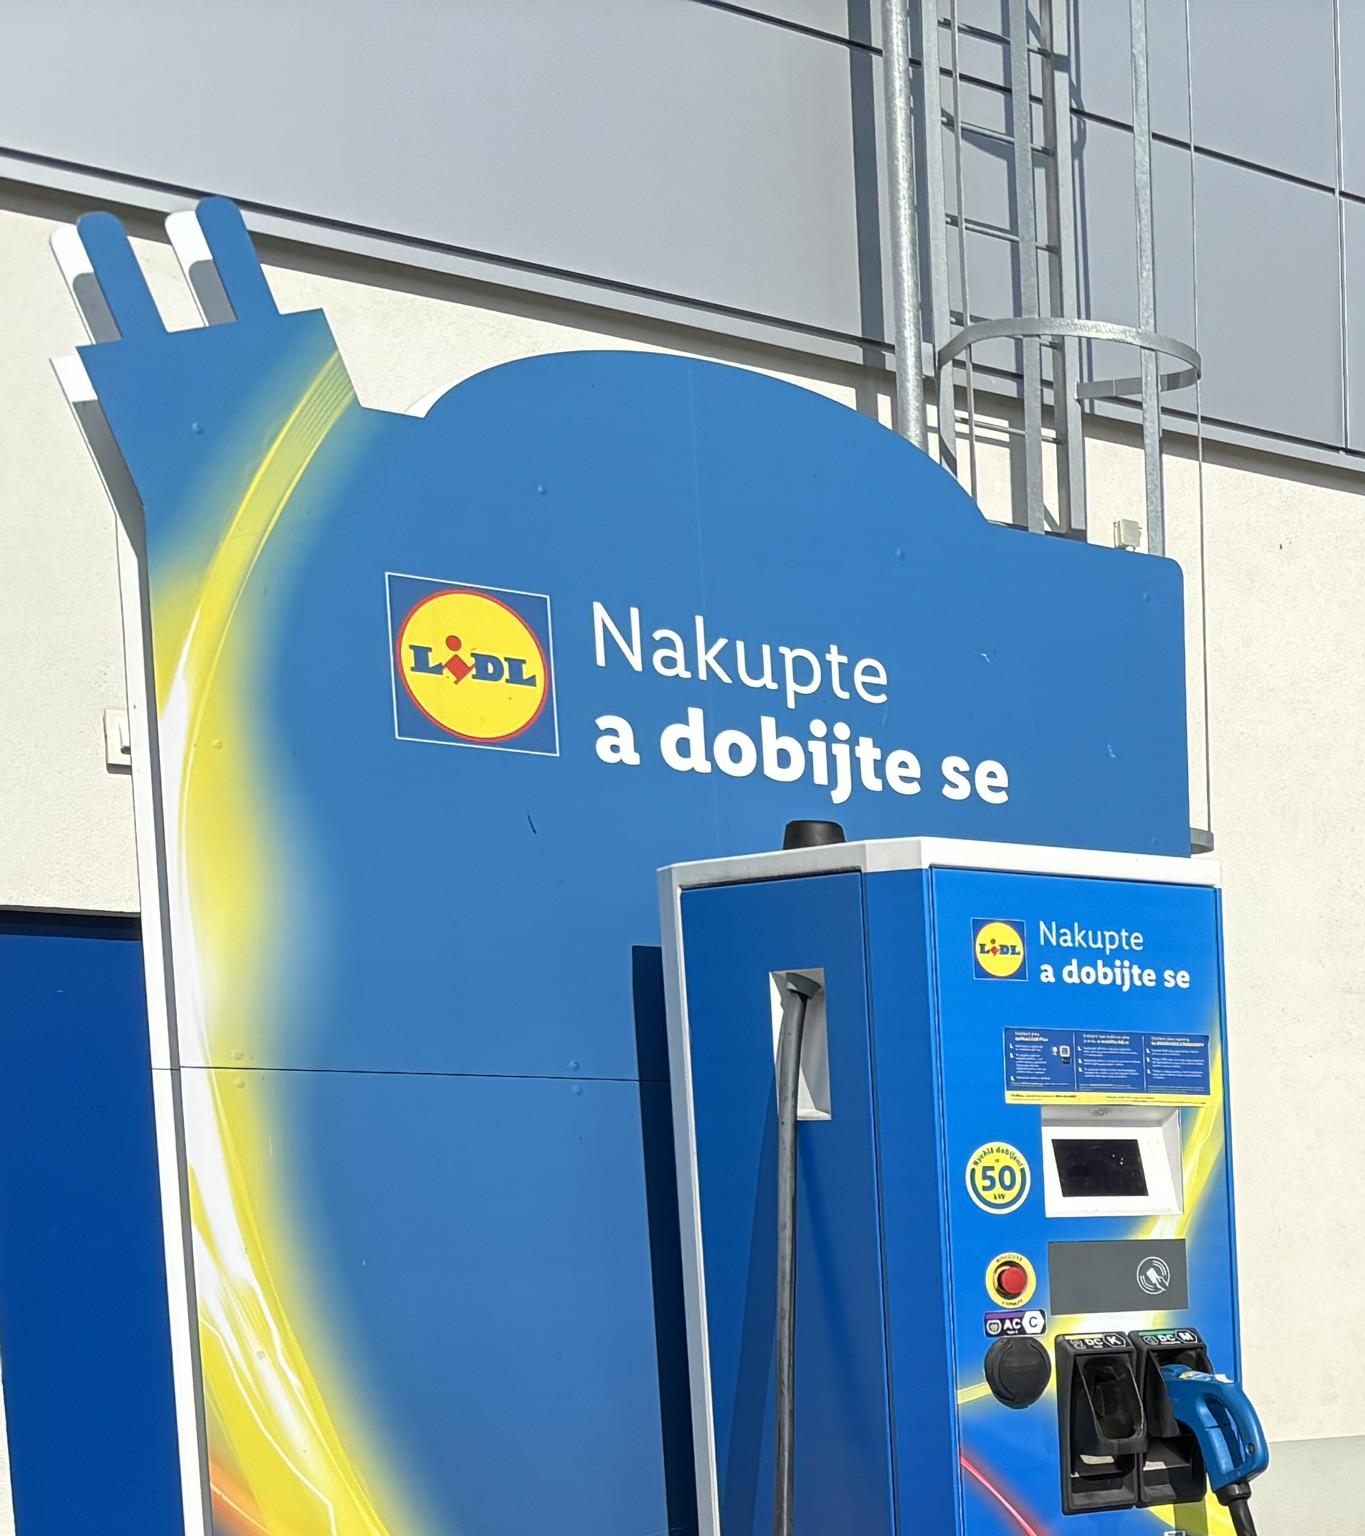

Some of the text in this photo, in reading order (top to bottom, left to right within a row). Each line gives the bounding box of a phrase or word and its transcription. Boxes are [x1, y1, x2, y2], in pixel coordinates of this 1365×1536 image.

[591, 600, 889, 709] Nakupte
[595, 706, 1010, 805] a dobijte se
[1039, 920, 1144, 955] Nakupte
[1039, 959, 1191, 992] a dobijte se
[981, 1164, 1017, 1192] 50
[1003, 1318, 1022, 1330] AC
[1028, 1316, 1038, 1328] C
[1084, 1337, 1104, 1346] DC
[1106, 1335, 1121, 1345] K
[1157, 1333, 1176, 1342] DC
[1178, 1331, 1194, 1341] M
